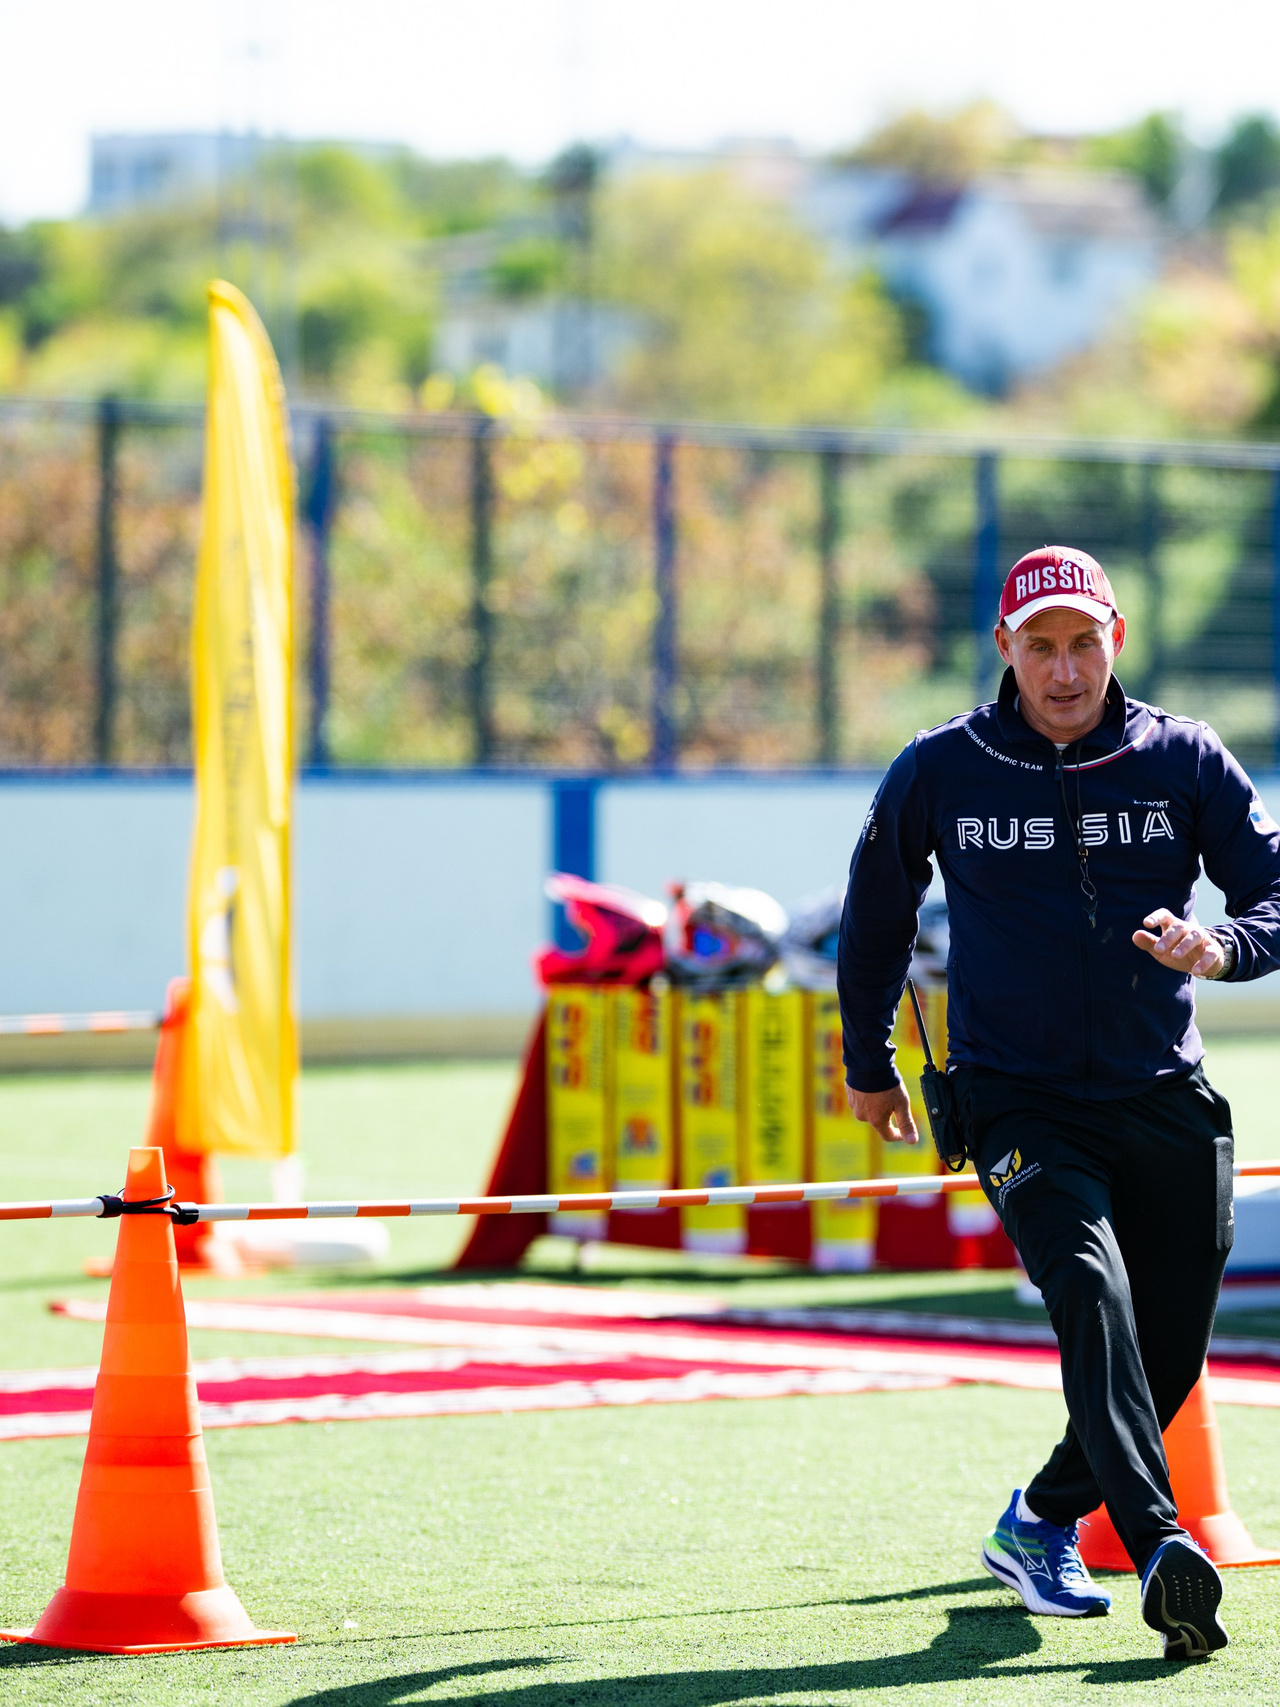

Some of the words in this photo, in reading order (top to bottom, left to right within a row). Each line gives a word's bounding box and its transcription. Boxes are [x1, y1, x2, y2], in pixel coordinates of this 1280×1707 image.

[1015, 565, 1096, 601] RUSSIA
[963, 723, 986, 748] RUSSIAN
[985, 746, 1018, 766] OLYMPIC
[1020, 761, 1043, 771] TEAM
